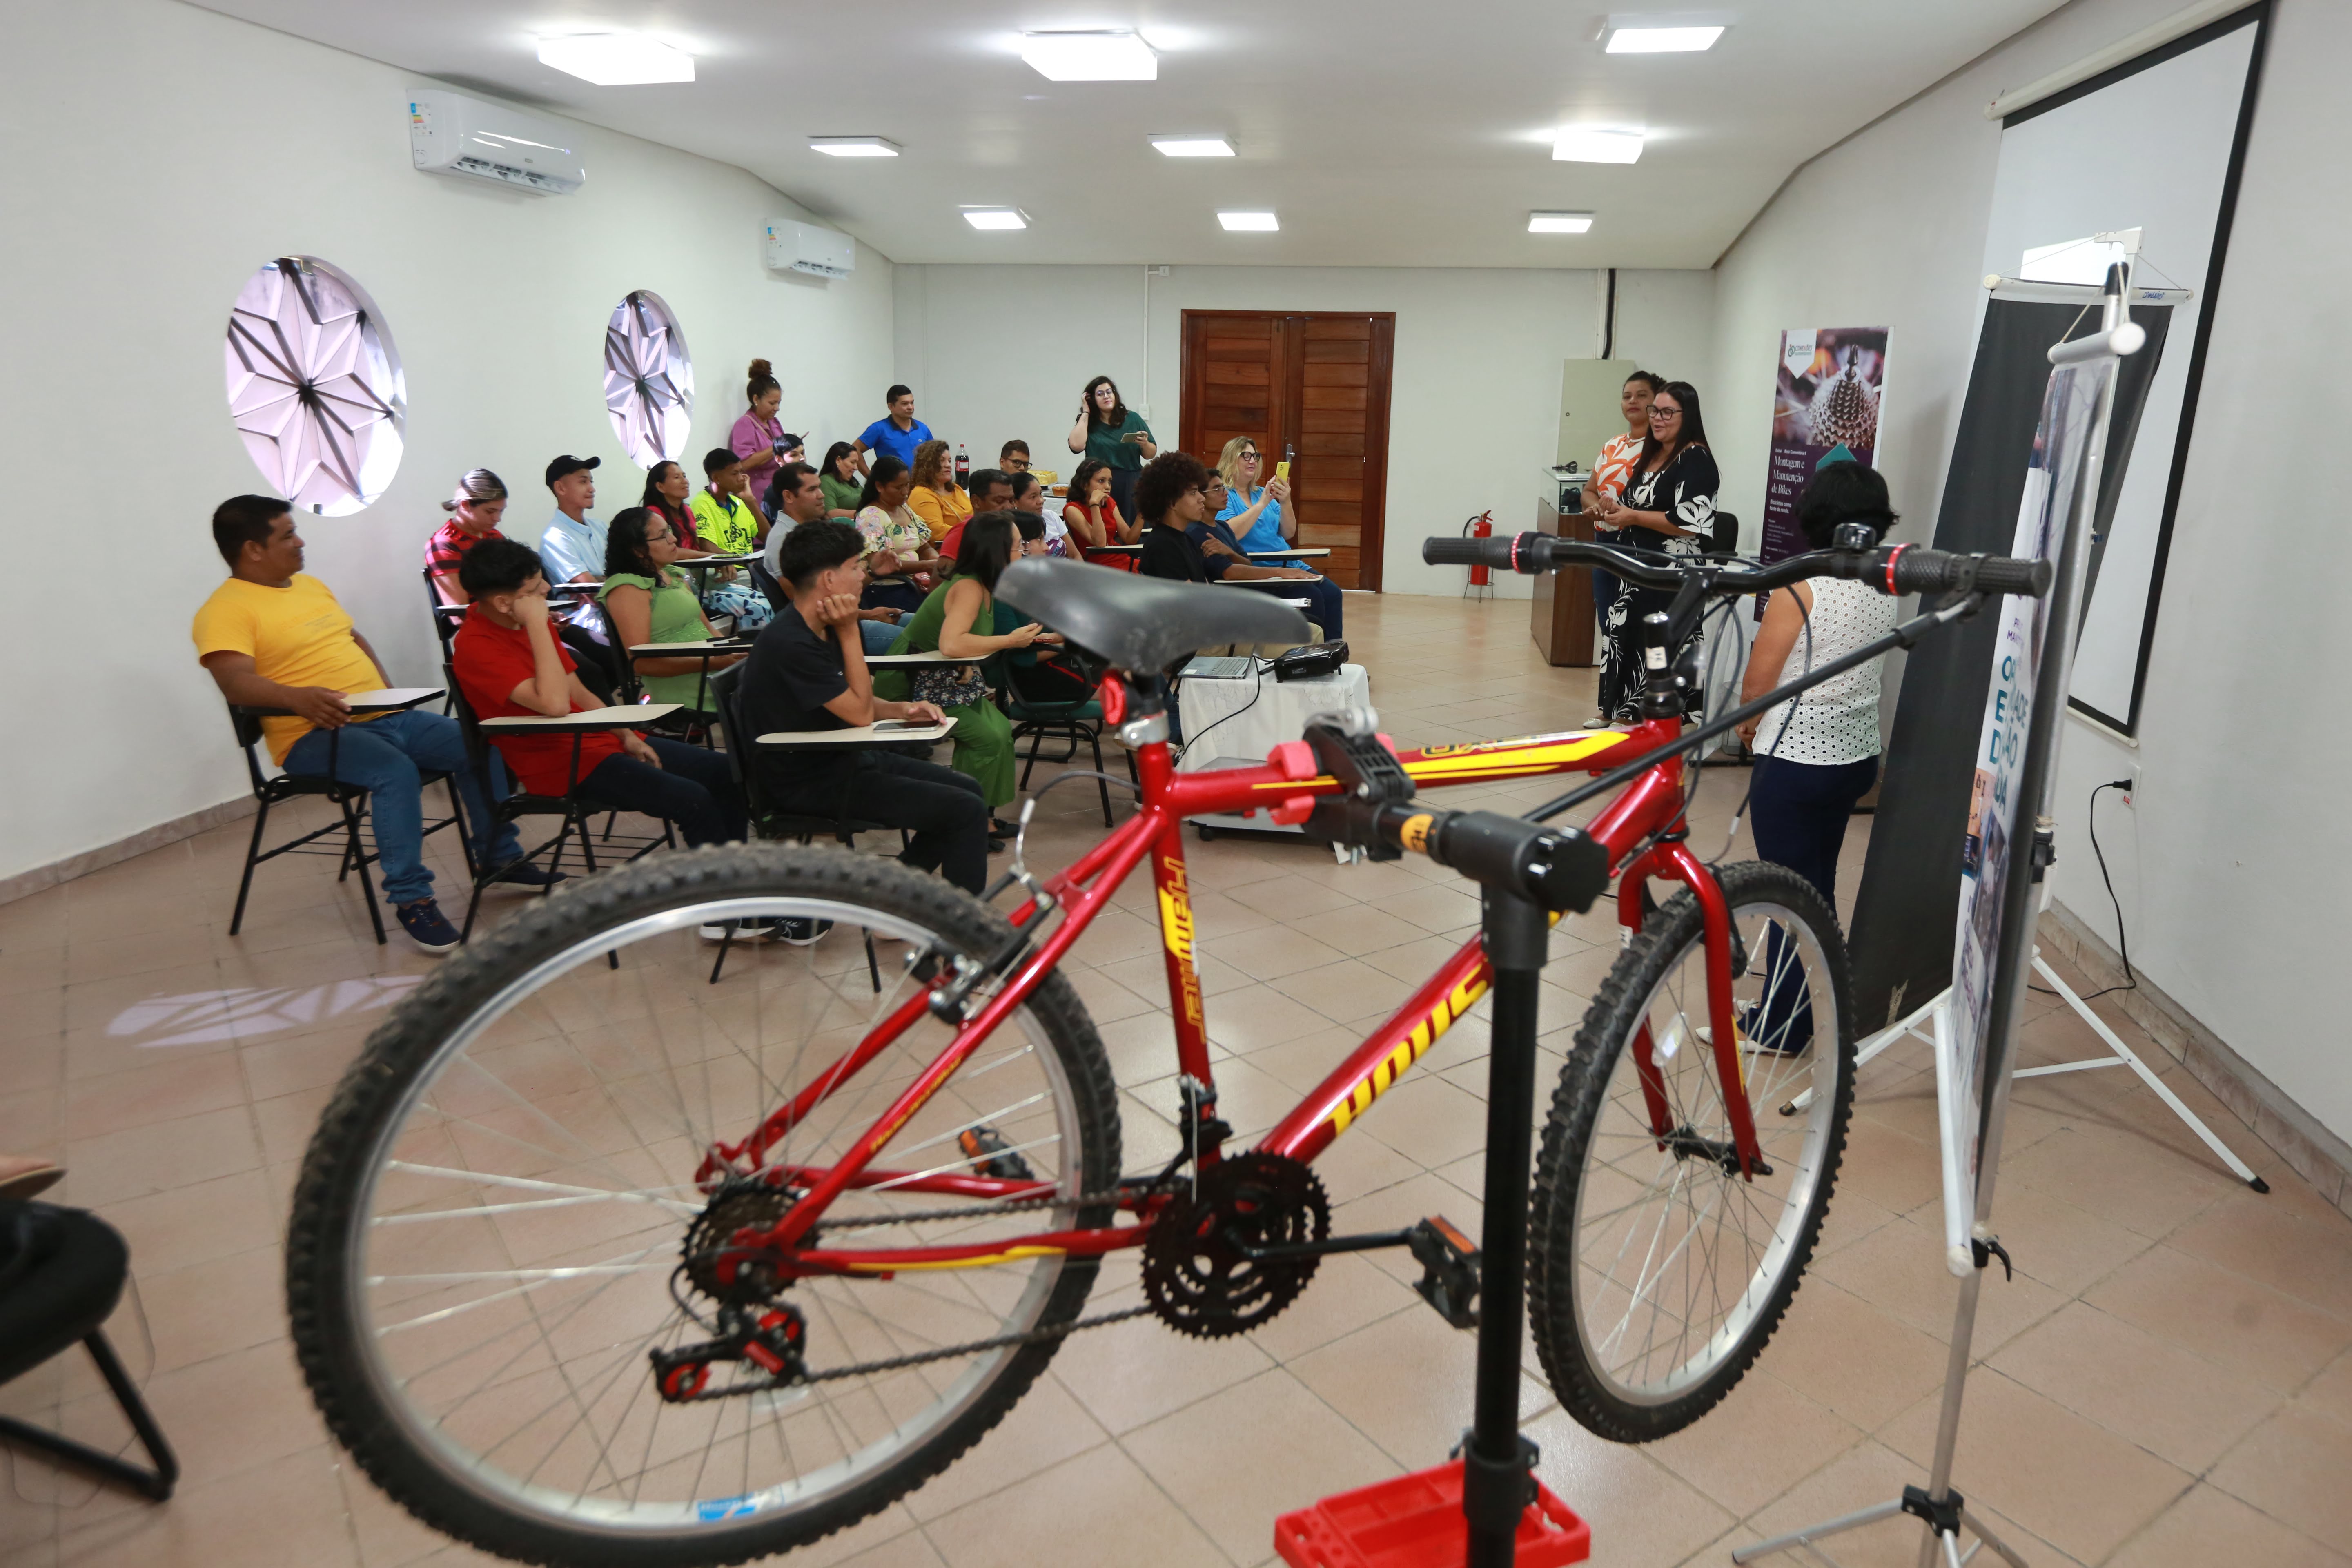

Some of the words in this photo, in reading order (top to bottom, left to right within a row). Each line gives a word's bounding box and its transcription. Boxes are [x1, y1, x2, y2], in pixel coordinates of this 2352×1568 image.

[1774, 455, 1801, 469] Montagem
[1773, 469, 1804, 484] Manutenção
[1771, 483, 1778, 494] de
[1778, 483, 1792, 495] Bikes
